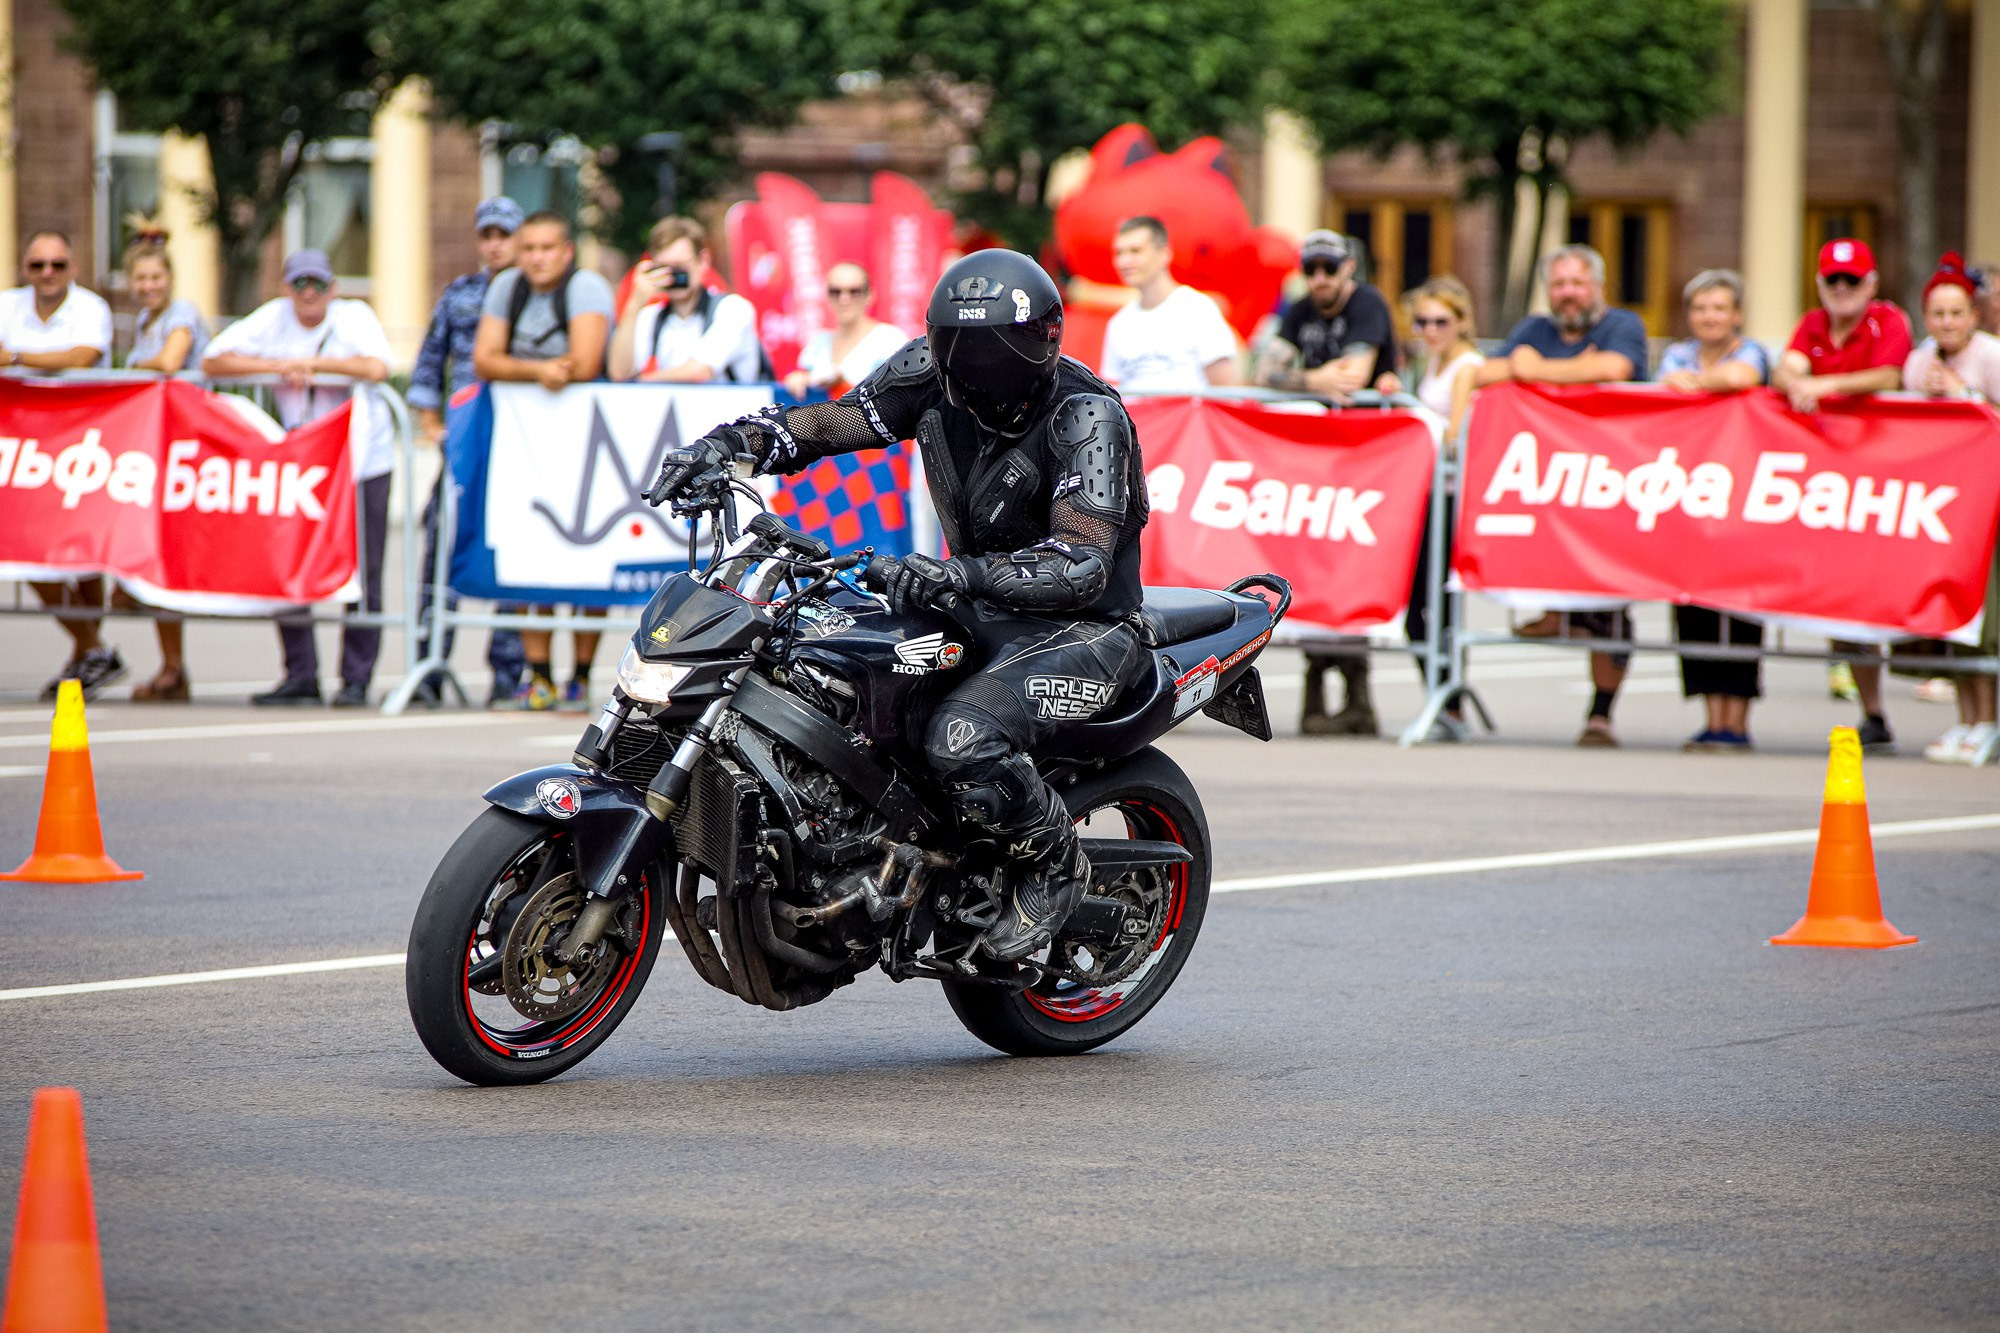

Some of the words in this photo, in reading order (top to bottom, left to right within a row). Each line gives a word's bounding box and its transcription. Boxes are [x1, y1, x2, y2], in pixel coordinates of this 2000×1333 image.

[163, 439, 330, 521] Банк
[1482, 431, 1735, 532] Альфа
[1742, 451, 1960, 545] Банк
[1190, 460, 1387, 547] Банк
[1222, 633, 1268, 671] СМОЛЕНСК
[891, 663, 940, 676] HON
[1028, 678, 1117, 705] ARLEN
[1192, 687, 1203, 703] 11
[1040, 697, 1101, 719] NESS
[516, 1047, 551, 1059] HONDA
